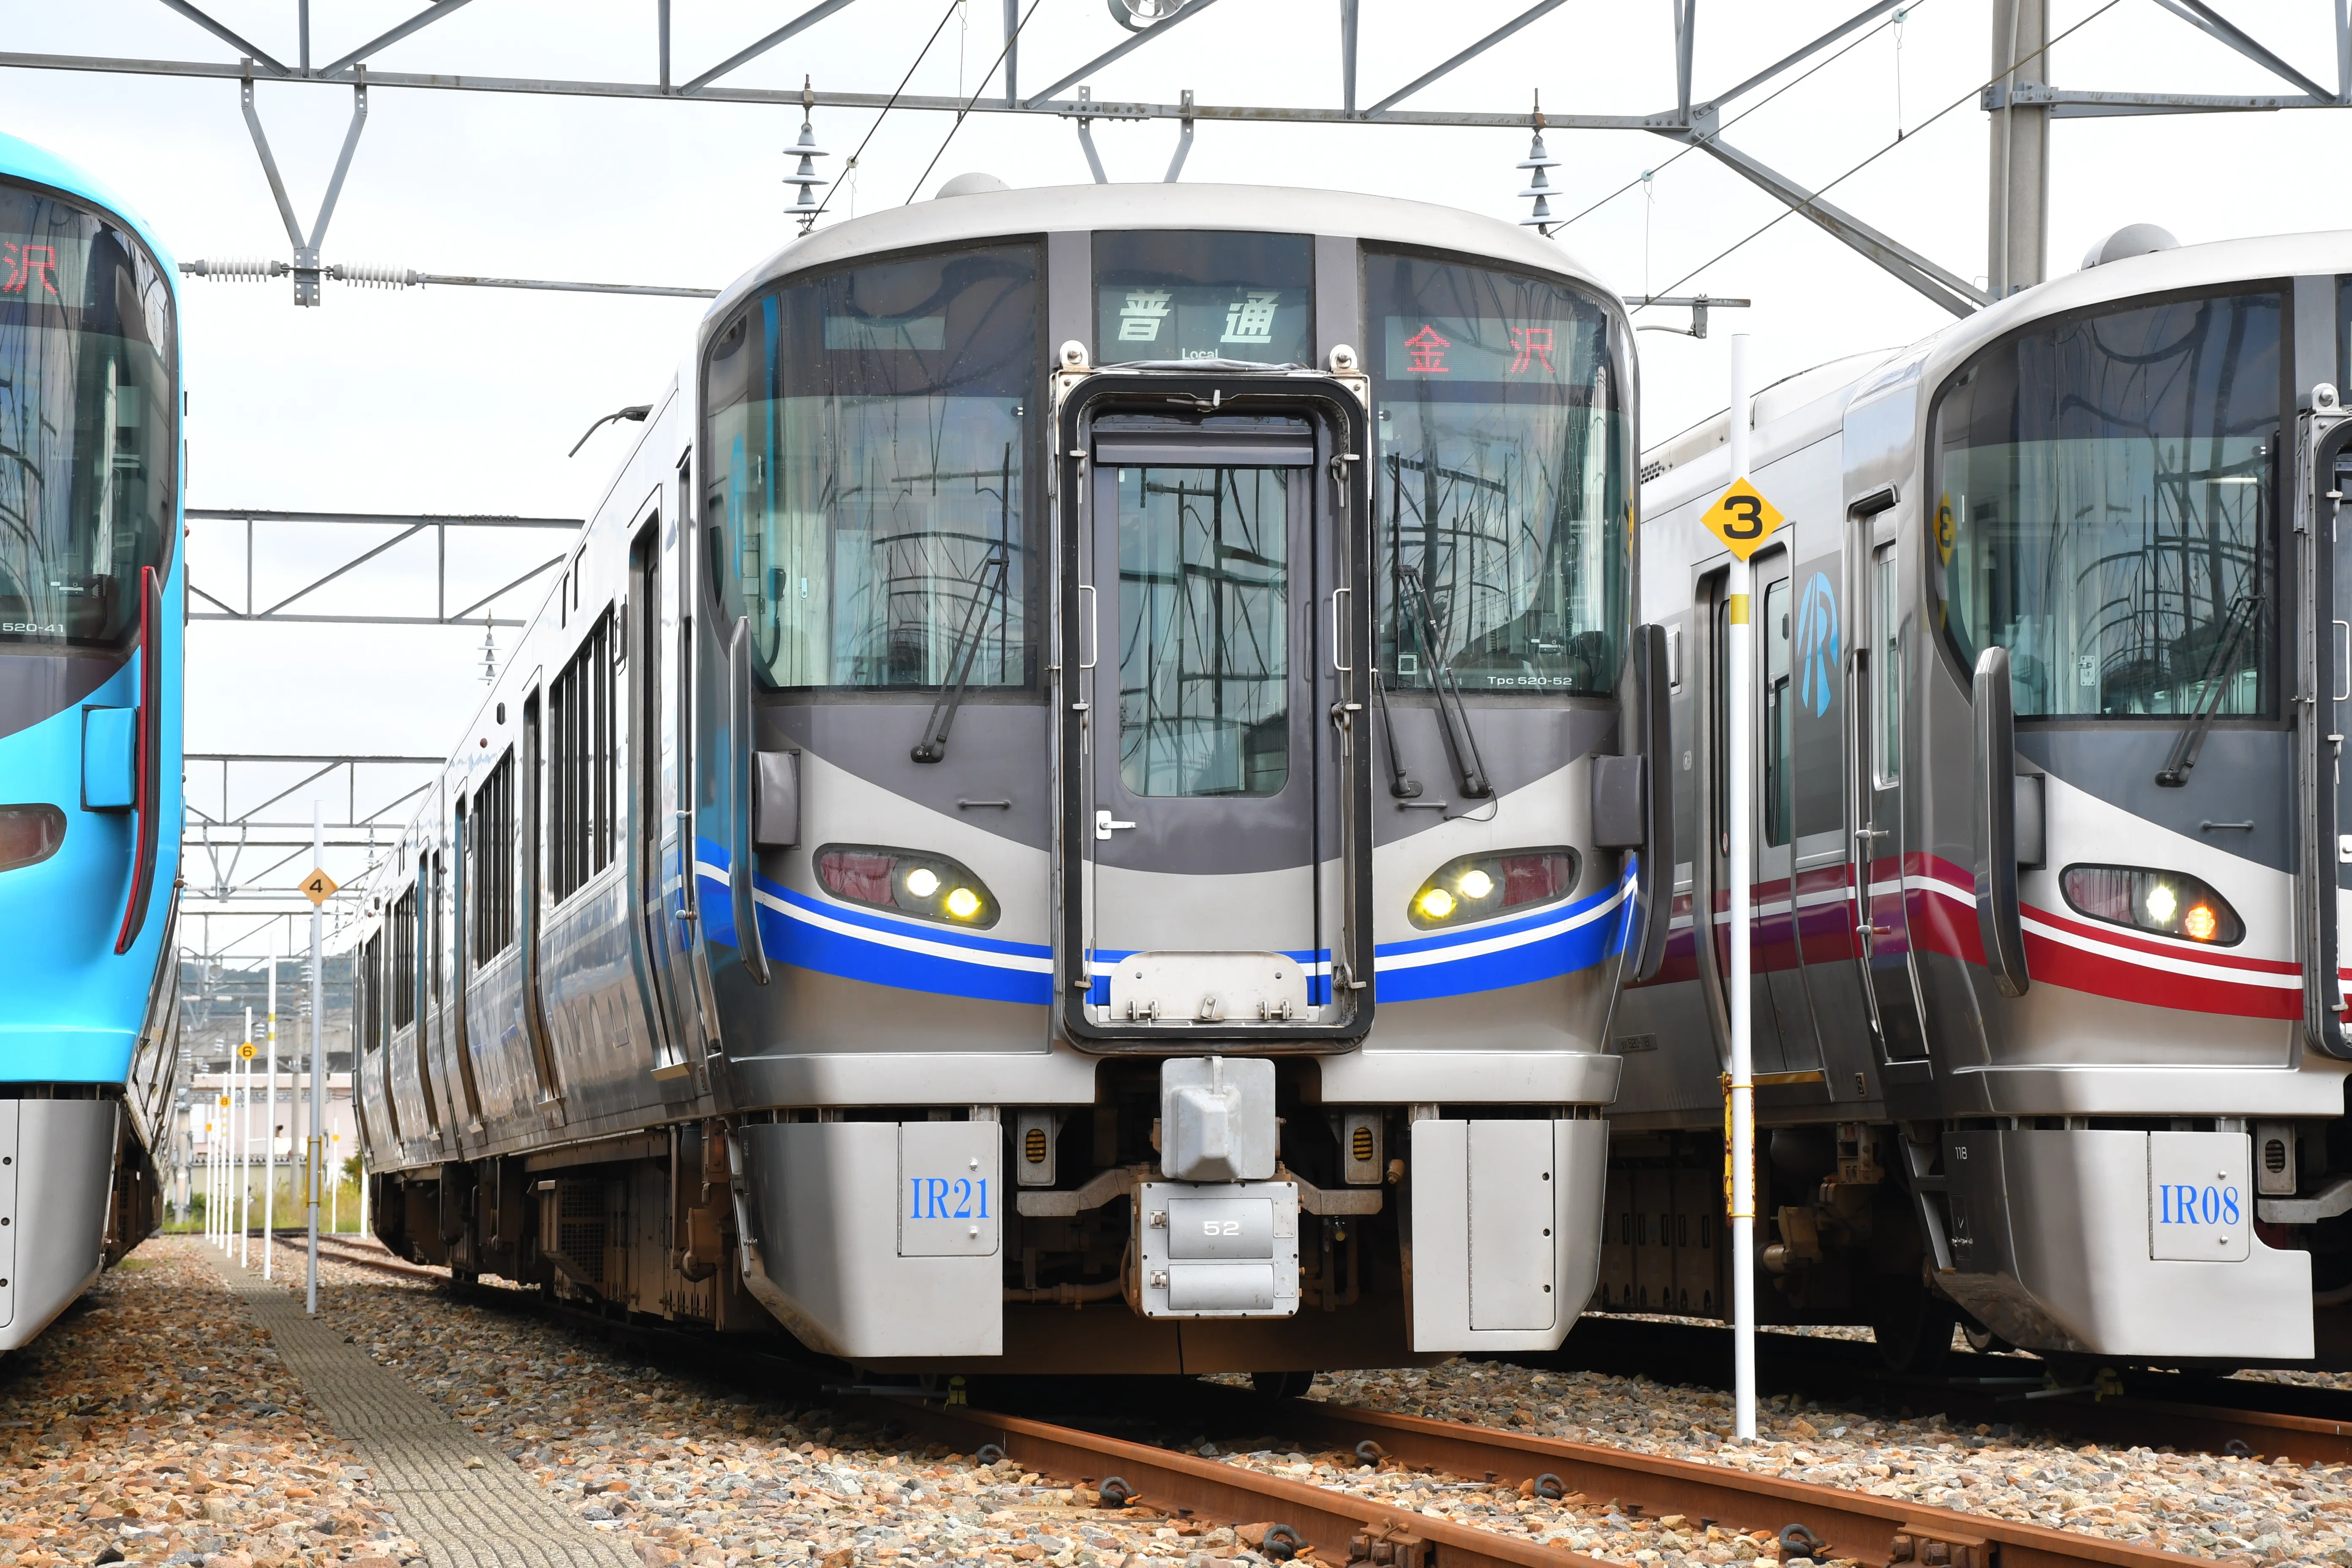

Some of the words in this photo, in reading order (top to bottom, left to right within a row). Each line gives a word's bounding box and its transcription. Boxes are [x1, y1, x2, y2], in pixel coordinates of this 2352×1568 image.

[3, 241, 57, 295] 沢
[1118, 289, 1282, 343] 普通
[1182, 348, 1218, 360] Local
[1405, 324, 1555, 373] 金沢
[1723, 495, 1763, 539] 3
[3, 623, 64, 633] 520-41
[1487, 676, 1514, 685] Tpc
[1518, 677, 1572, 685] 520-52
[309, 879, 323, 893] 4
[243, 1046, 252, 1057] 6
[1955, 1146, 1967, 1160] 118
[910, 1178, 990, 1218] IR21
[2159, 1185, 2239, 1225] IR08
[1204, 1221, 1239, 1235] 52
